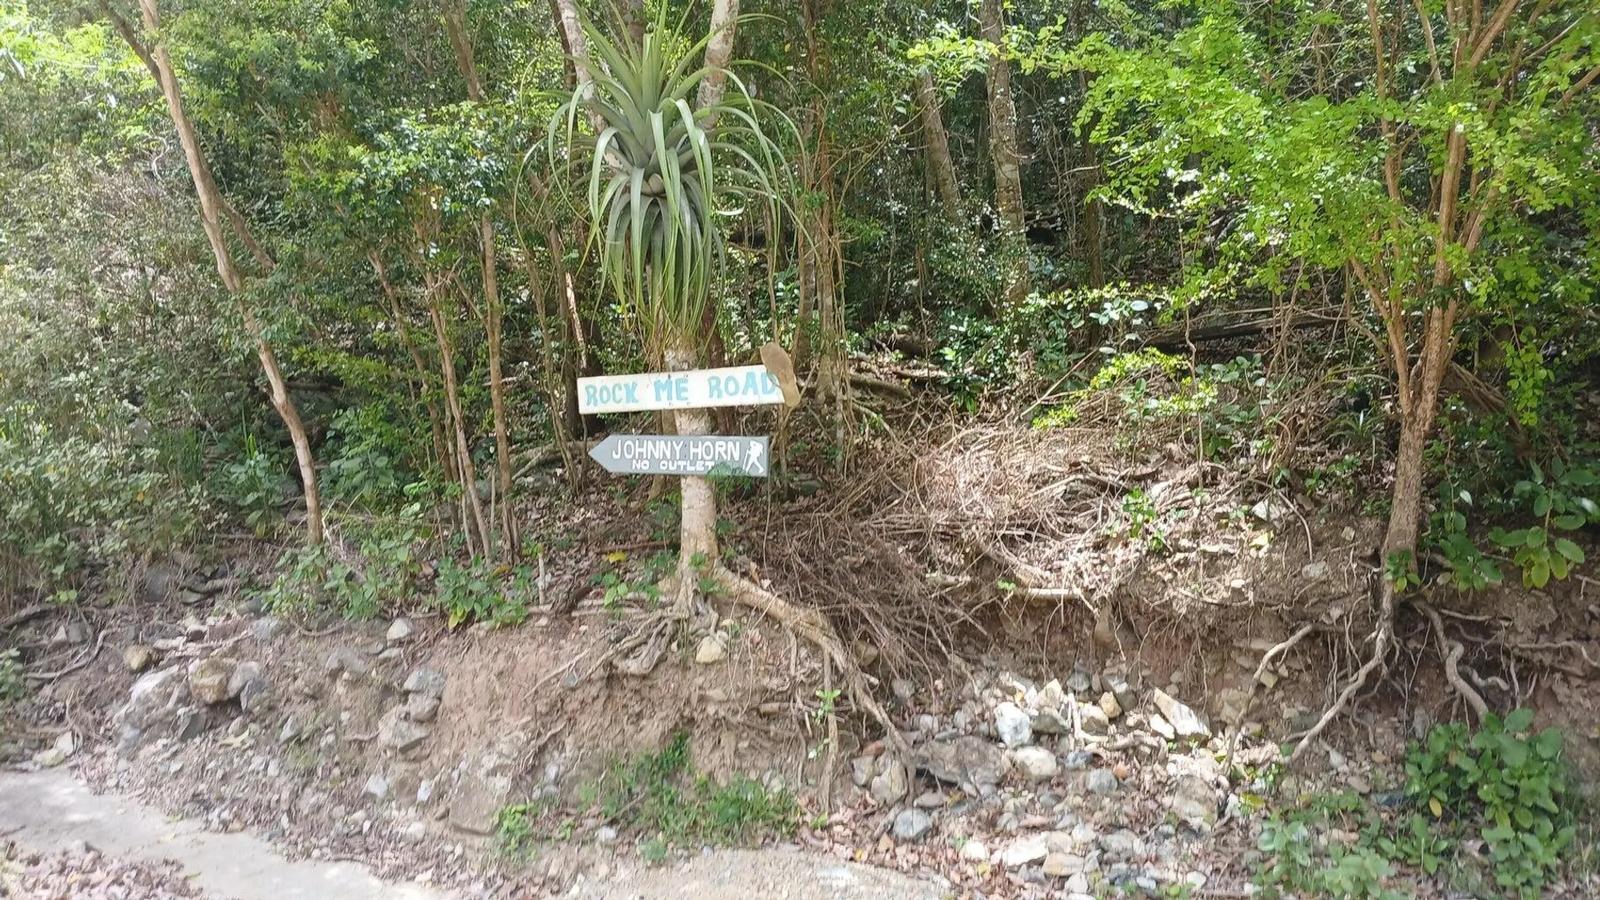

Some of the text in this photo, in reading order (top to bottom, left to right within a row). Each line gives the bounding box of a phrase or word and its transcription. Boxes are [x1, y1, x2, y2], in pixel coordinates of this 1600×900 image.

[584, 371, 776, 407] ROCK ME ROAD
[612, 439, 740, 461] JOHNNY HORN
[632, 459, 715, 471] NO OUTLET
